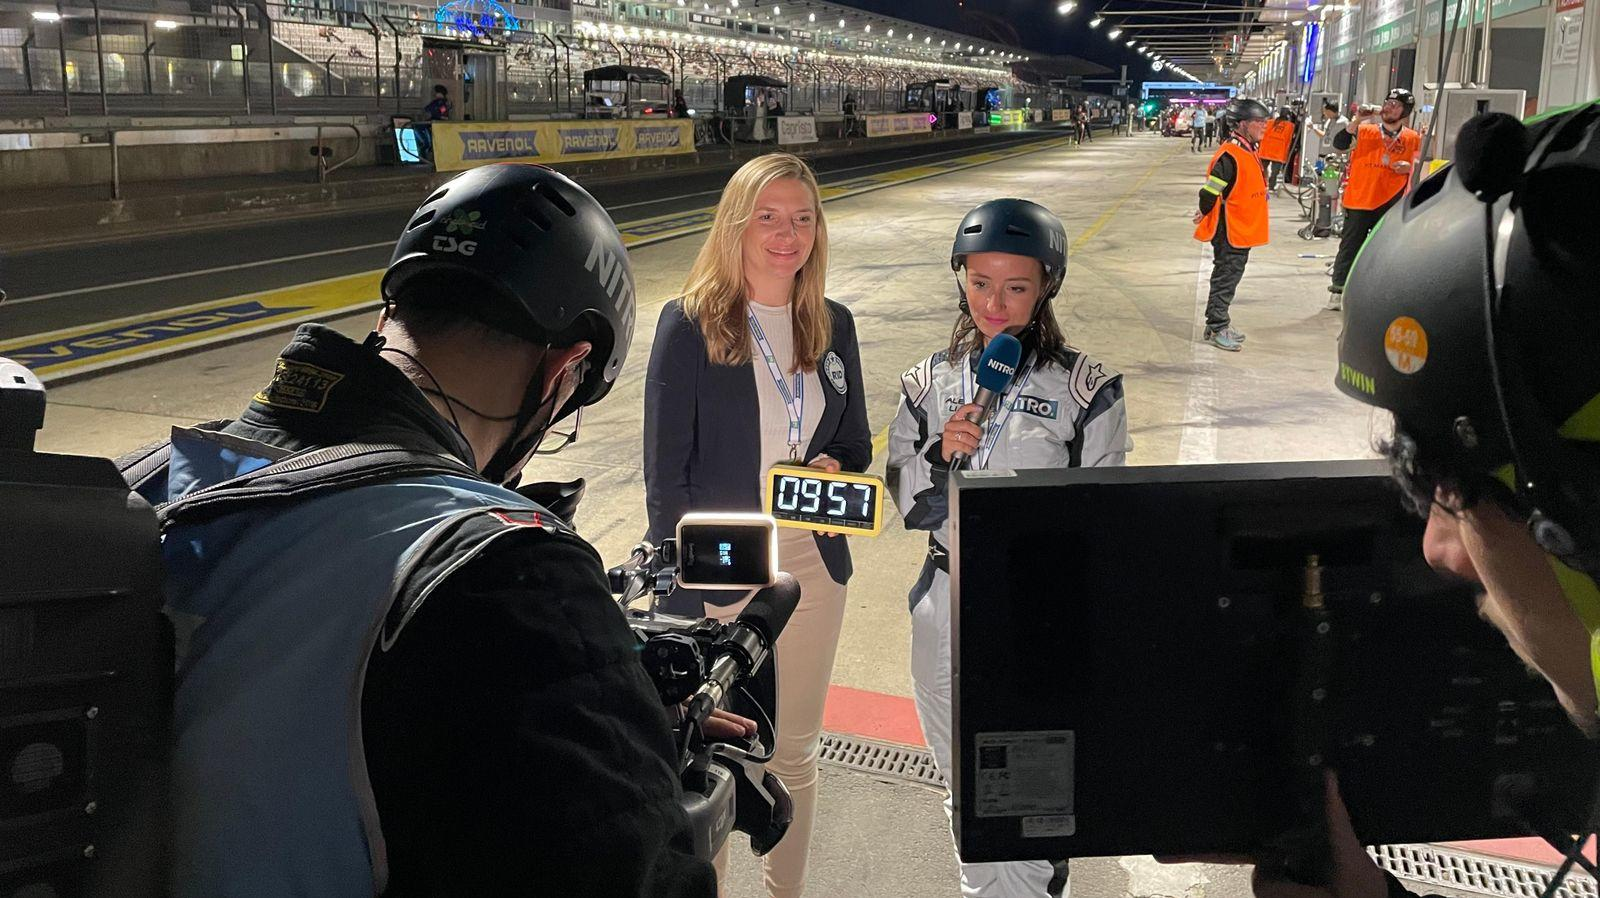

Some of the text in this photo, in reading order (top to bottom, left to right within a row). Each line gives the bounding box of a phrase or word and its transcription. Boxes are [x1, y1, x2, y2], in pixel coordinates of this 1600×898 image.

[467, 137, 533, 153] RAVENOL
[564, 133, 616, 148] RAVENOL
[432, 235, 478, 256] TSG
[7, 309, 266, 365] VENOL
[987, 358, 1015, 375] NITRO
[1003, 395, 1054, 417] ITRO.
